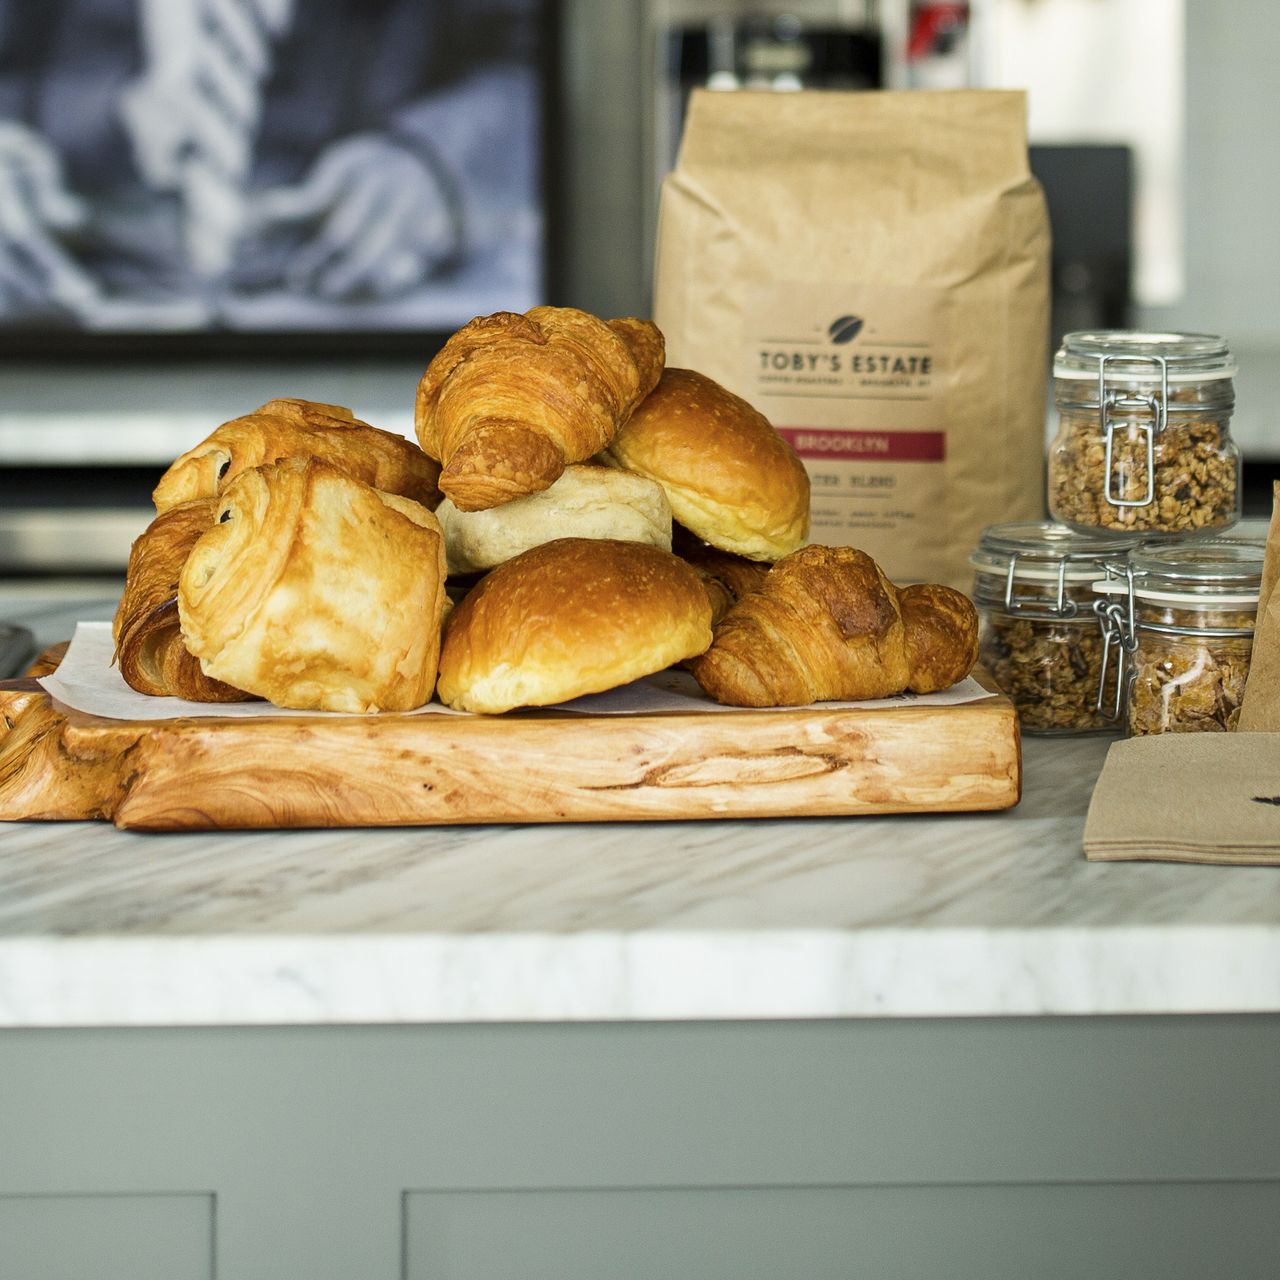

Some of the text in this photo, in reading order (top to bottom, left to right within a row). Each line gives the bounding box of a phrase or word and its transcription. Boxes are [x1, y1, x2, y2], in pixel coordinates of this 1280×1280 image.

[759, 352, 932, 374] TOBY'S ESTATE
[795, 435, 890, 453] BROOKLYN
